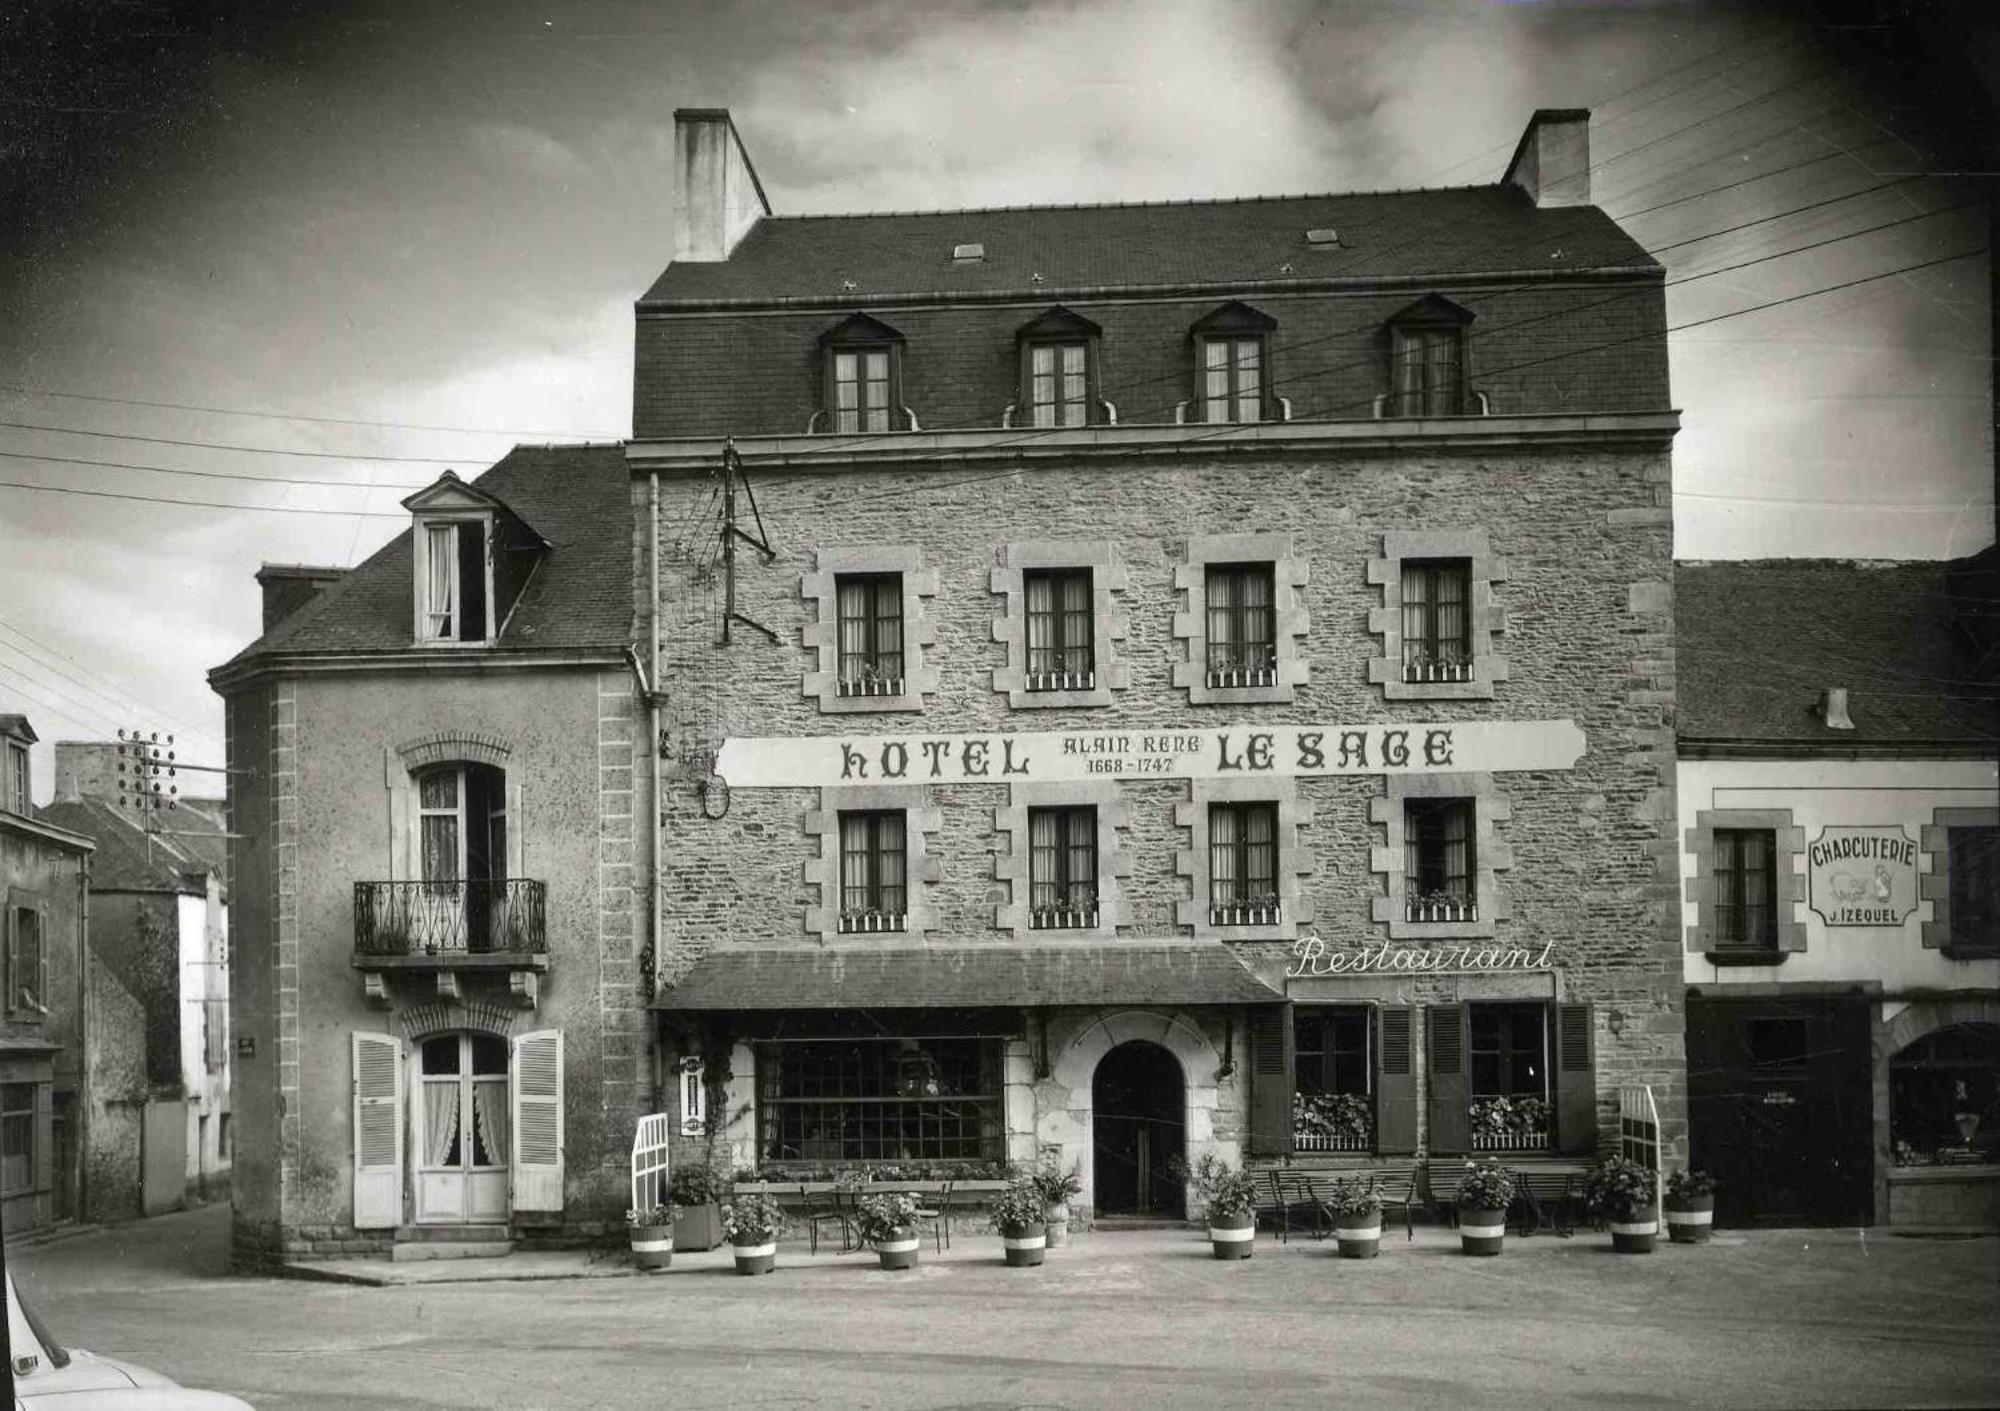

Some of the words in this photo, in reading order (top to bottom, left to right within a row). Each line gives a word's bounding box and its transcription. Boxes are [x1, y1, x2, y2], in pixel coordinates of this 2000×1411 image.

[1063, 737, 1130, 754] ALAIN
[1217, 733, 1275, 771] LE
[1296, 729, 1453, 769] SAGE
[1812, 836, 1915, 867] CHARCUTERIE
[1286, 935, 1553, 977] Restaurant
